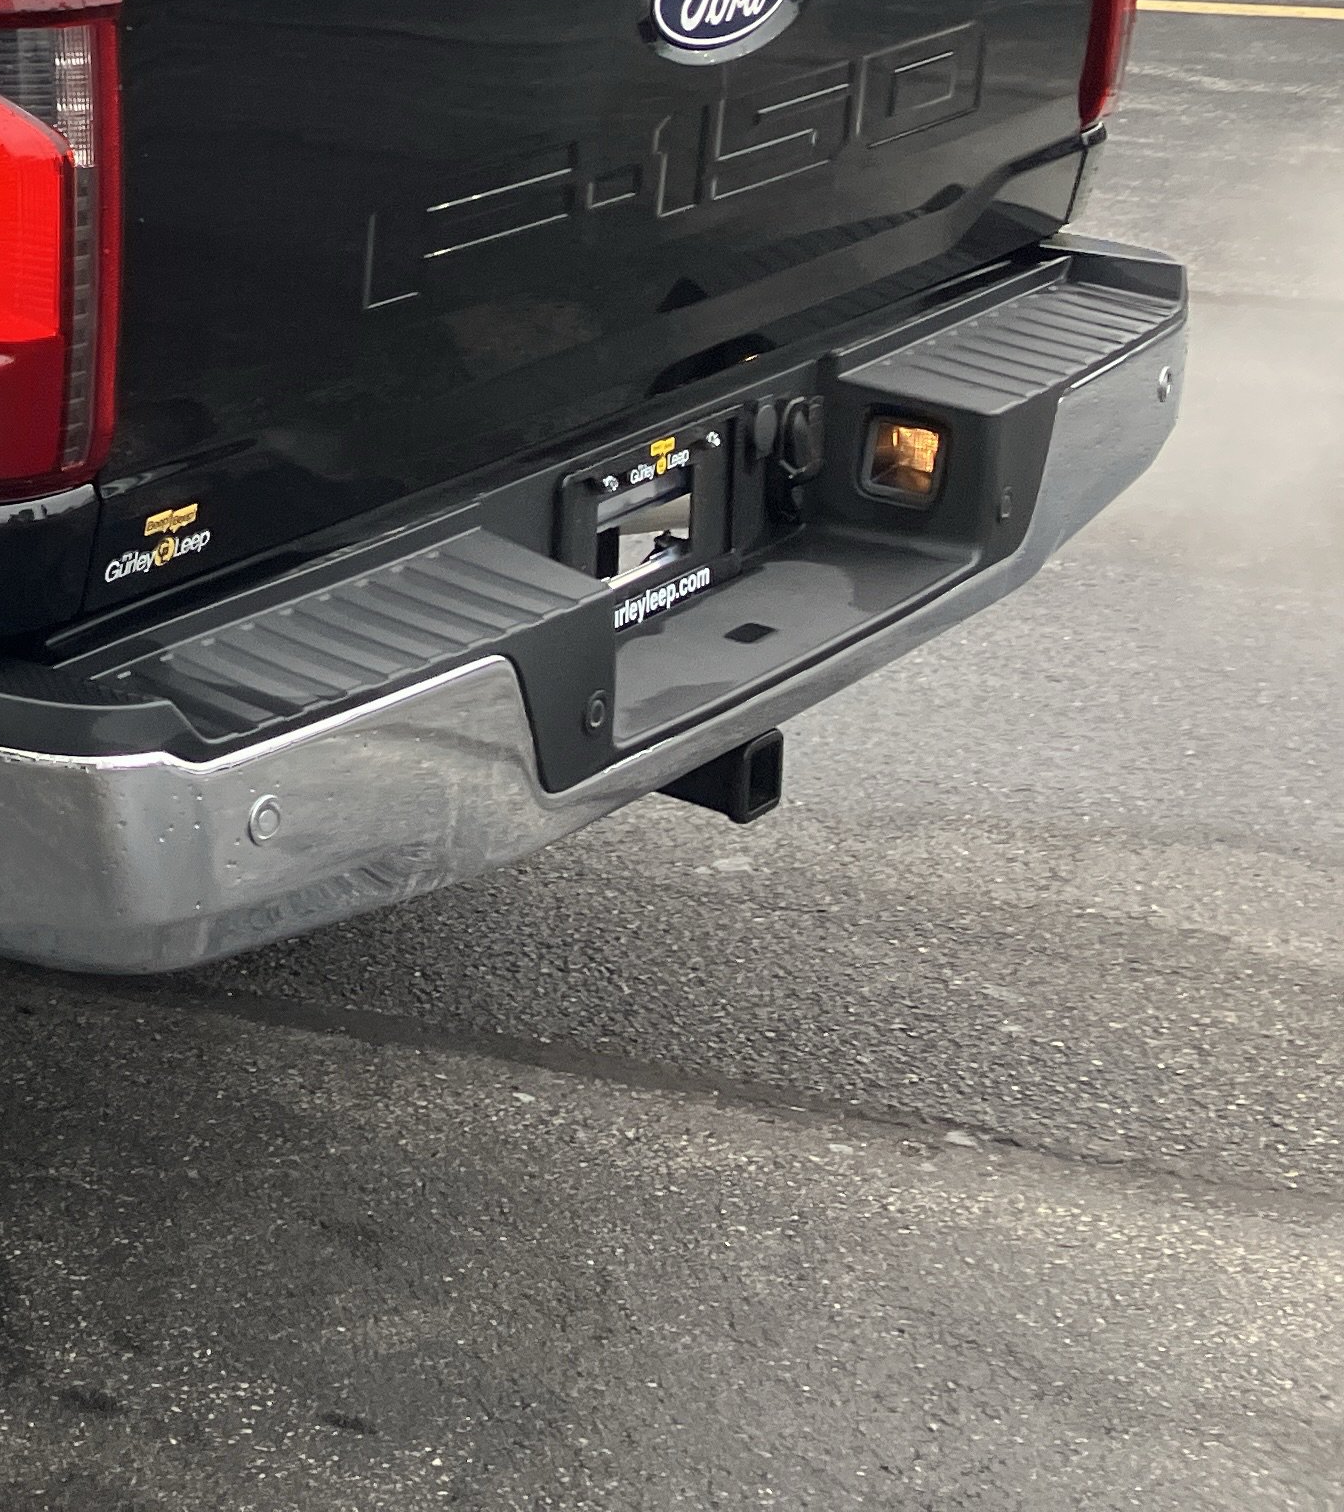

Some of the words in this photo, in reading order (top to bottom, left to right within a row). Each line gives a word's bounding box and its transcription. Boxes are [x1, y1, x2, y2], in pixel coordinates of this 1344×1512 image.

[666, 449, 690, 470] Leep
[105, 550, 155, 582] Gurley
[174, 530, 210, 556] Leep
